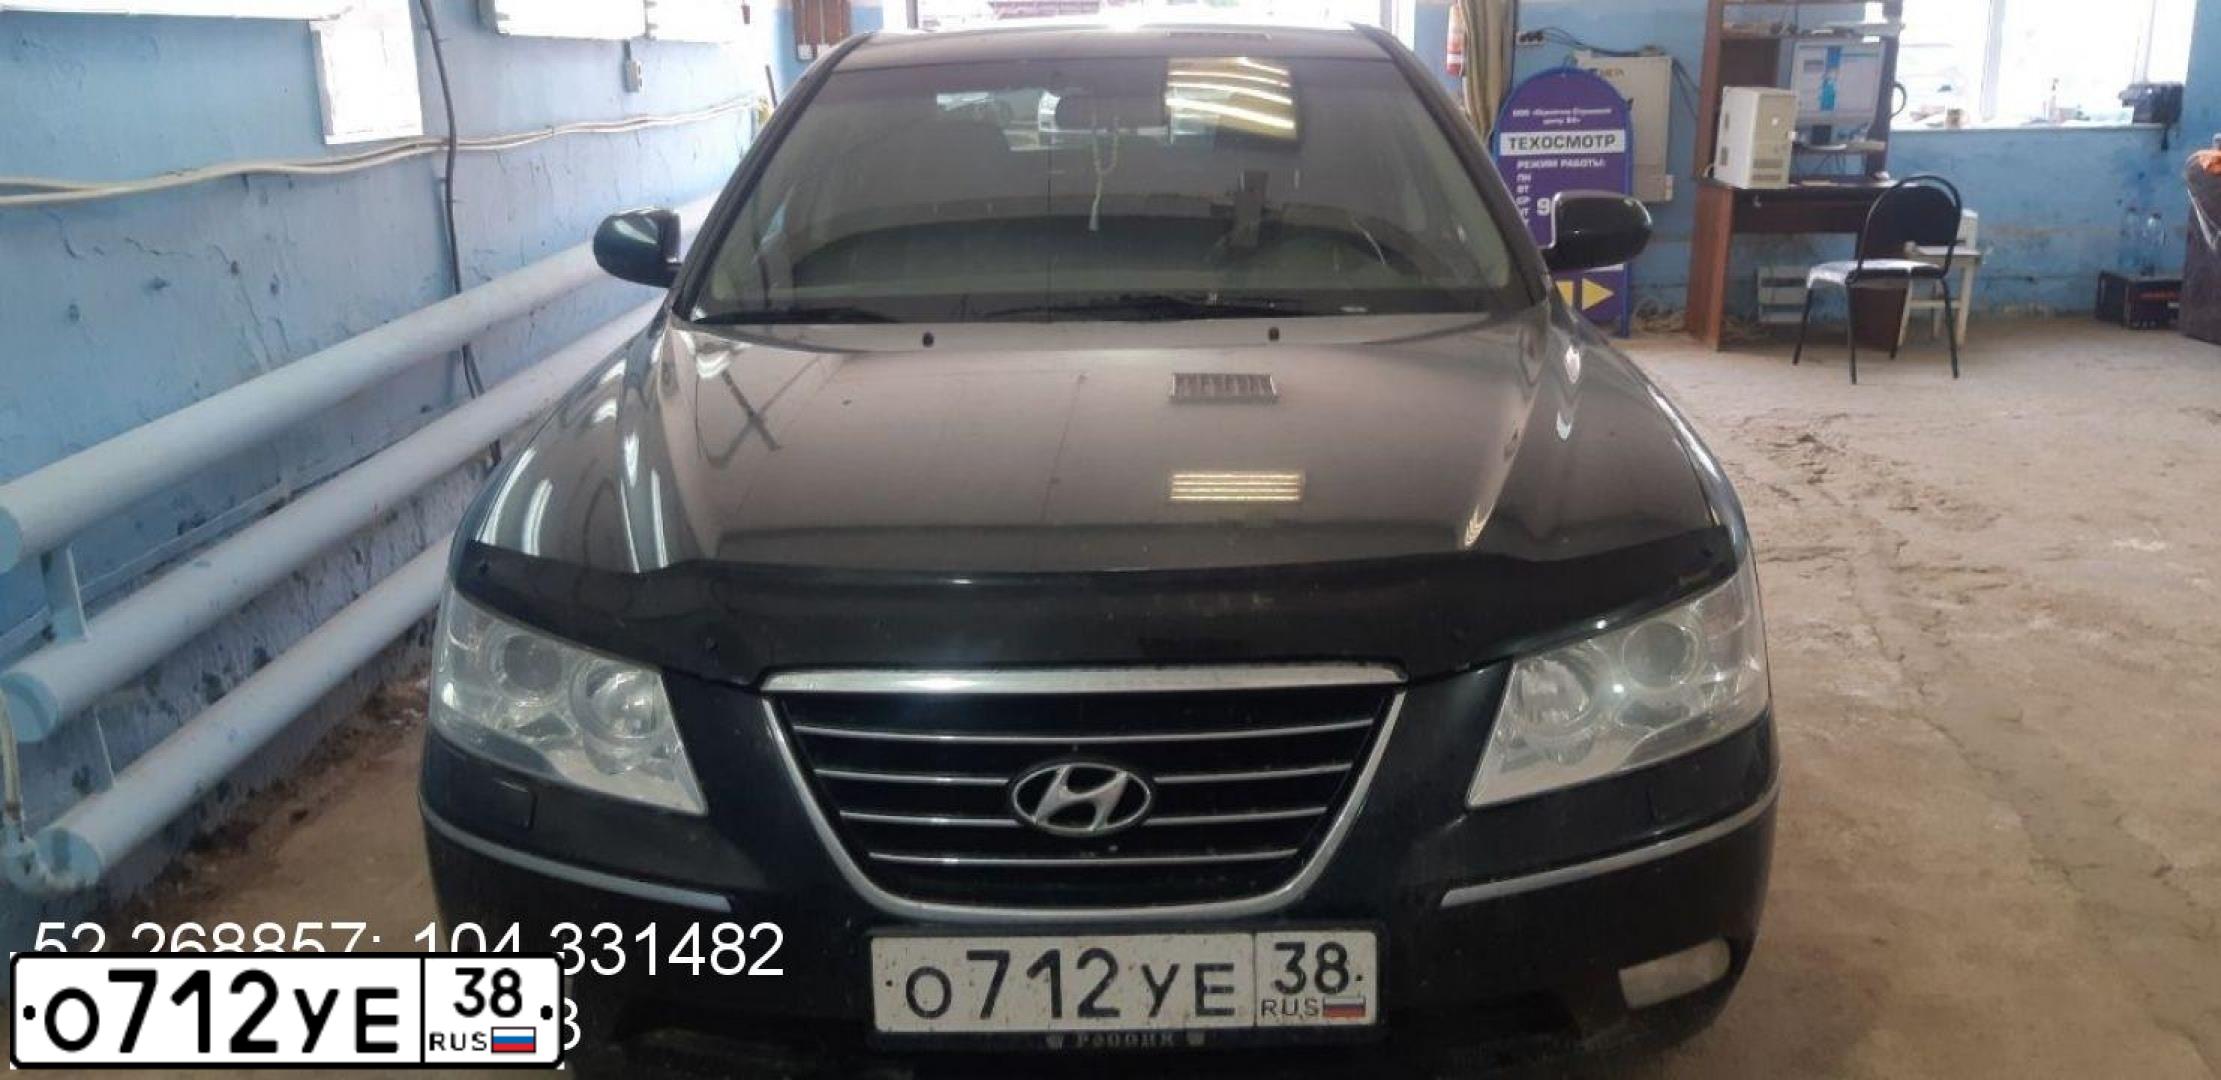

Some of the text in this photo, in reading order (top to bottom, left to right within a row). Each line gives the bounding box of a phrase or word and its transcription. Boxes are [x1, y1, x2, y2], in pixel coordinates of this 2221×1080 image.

[1507, 134, 1616, 150] ТЕХОСМОТР
[1516, 159, 1558, 169] РЕЖИМ
[1274, 941, 1349, 994] 38
[905, 947, 1236, 1020] О712УЕ
[1260, 999, 1319, 1017] RUS
